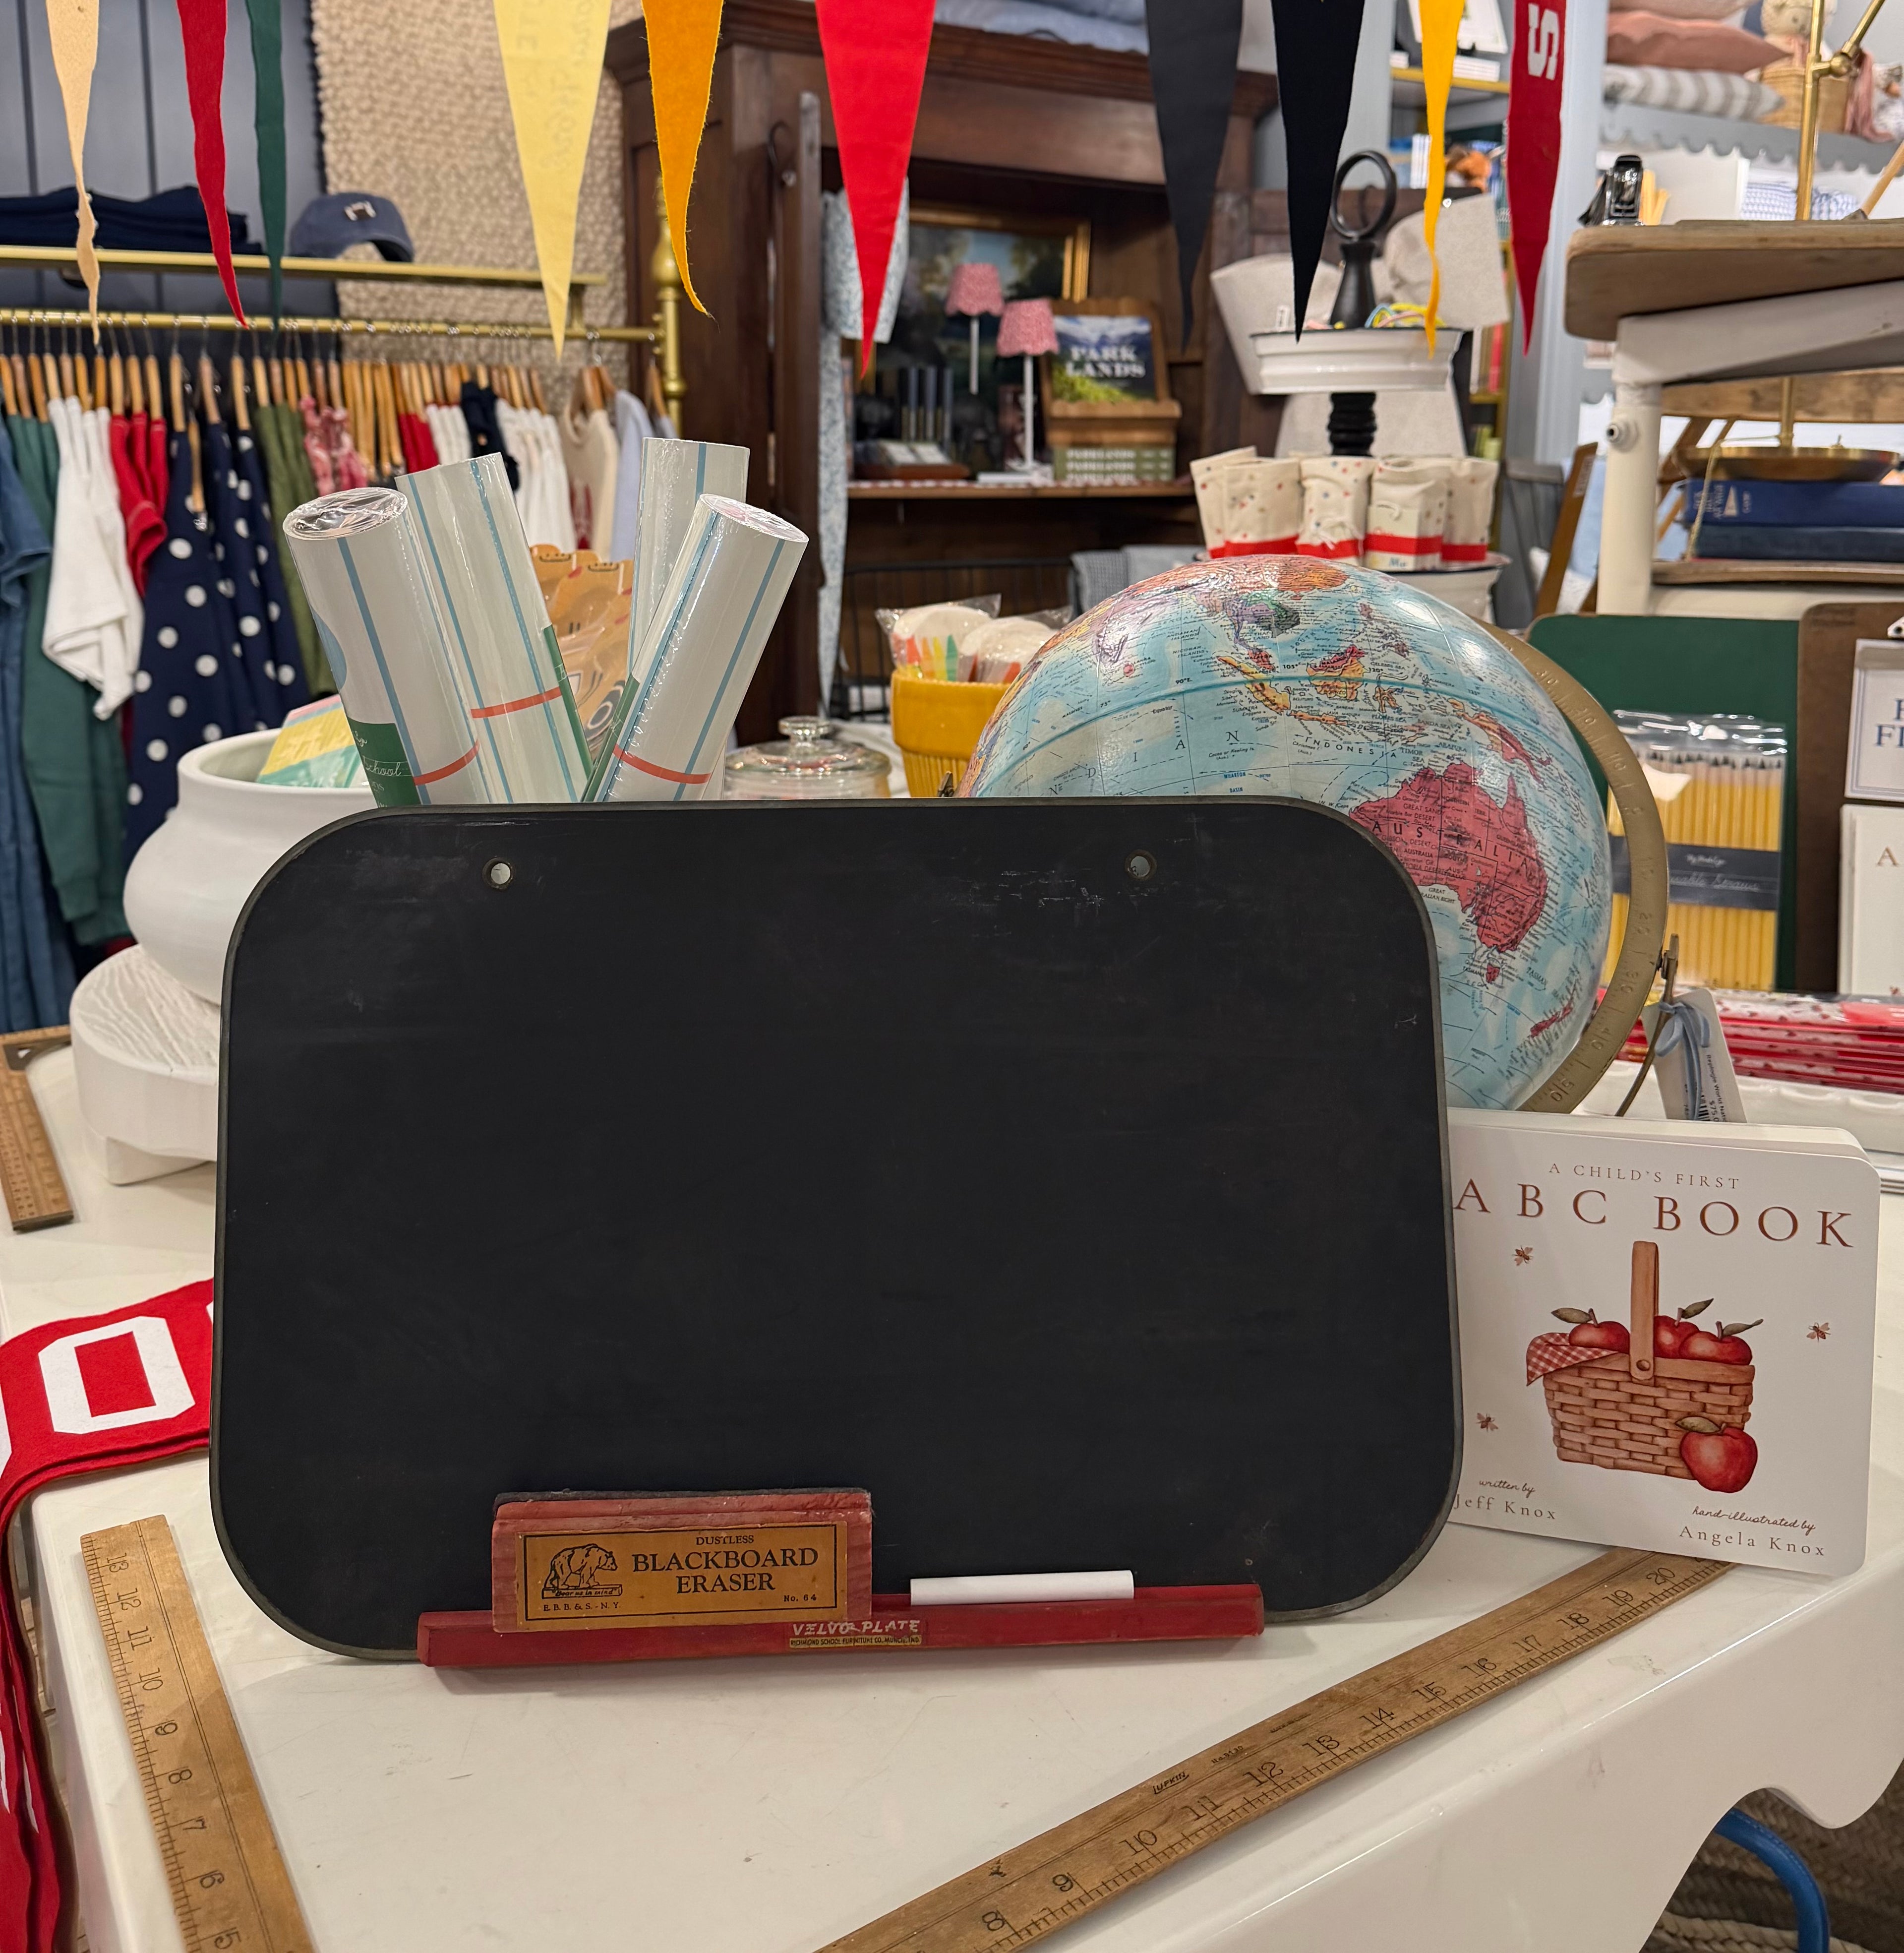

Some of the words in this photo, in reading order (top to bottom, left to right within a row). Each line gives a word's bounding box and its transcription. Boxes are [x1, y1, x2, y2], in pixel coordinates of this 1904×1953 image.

[1071, 346, 1136, 361] PARK
[1067, 362, 1146, 378] LANDS
[1549, 1163, 1560, 1174] A
[1574, 1165, 1663, 1183] CHILD'S
[1676, 1174, 1740, 1189] FIRST
[1653, 1195, 1854, 1248] BOOK
[1480, 1479, 1520, 1492] written
[1522, 1483, 1536, 1498] by
[1453, 1493, 1494, 1511] Jeff
[1504, 1501, 1556, 1520] Knox
[1692, 1506, 1799, 1528] hand-illustrated
[1800, 1520, 1816, 1536] by
[696, 1535, 754, 1546] DUSTLESS
[1679, 1525, 1755, 1547] Angela
[1769, 1537, 1826, 1557] Knox
[107, 1552, 129, 1573] 13
[632, 1547, 819, 1573] BLACKBOARD
[675, 1573, 775, 1594] ERASER
[1646, 1567, 1676, 1586] 20
[117, 1587, 142, 1611] 12
[1602, 1589, 1634, 1608] 19
[1556, 1612, 1590, 1631] 18
[127, 1625, 153, 1651] 11
[1512, 1634, 1543, 1654] 17
[138, 1667, 164, 1691] 10
[1461, 1657, 1497, 1680] 16
[1412, 1681, 1447, 1704] 15
[155, 1721, 178, 1736] 9
[1359, 1707, 1397, 1730] 14
[1302, 1735, 1340, 1758] 13
[168, 1769, 193, 1785] 8
[1153, 1771, 1190, 1795] LUFKIN
[1242, 1762, 1284, 1787] 12
[1180, 1794, 1224, 1822] 11
[182, 1816, 207, 1831] 7
[1119, 1830, 1158, 1856] 10
[200, 1871, 225, 1889] 6
[1052, 1873, 1074, 1892] 9
[981, 1910, 1006, 1933] 8
[214, 1929, 242, 1950] 5
